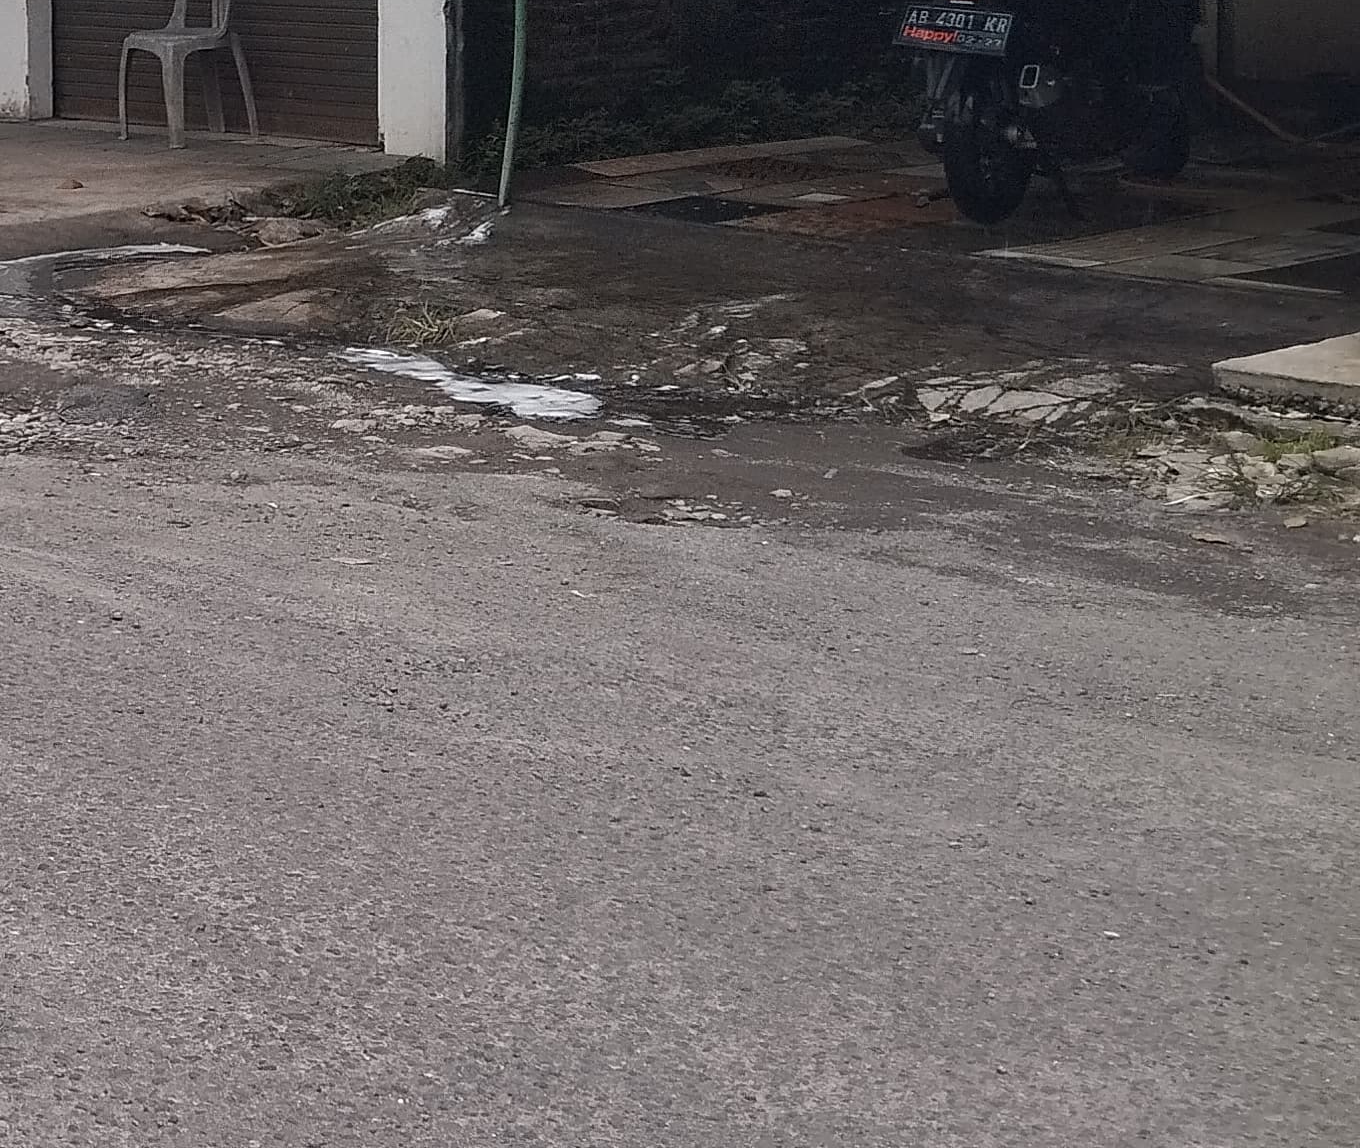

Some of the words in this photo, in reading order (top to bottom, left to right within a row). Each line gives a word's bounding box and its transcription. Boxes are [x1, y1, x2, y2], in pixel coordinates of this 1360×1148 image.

[907, 10, 929, 24] AB
[935, 12, 976, 30] 4301
[982, 15, 1008, 33] KR
